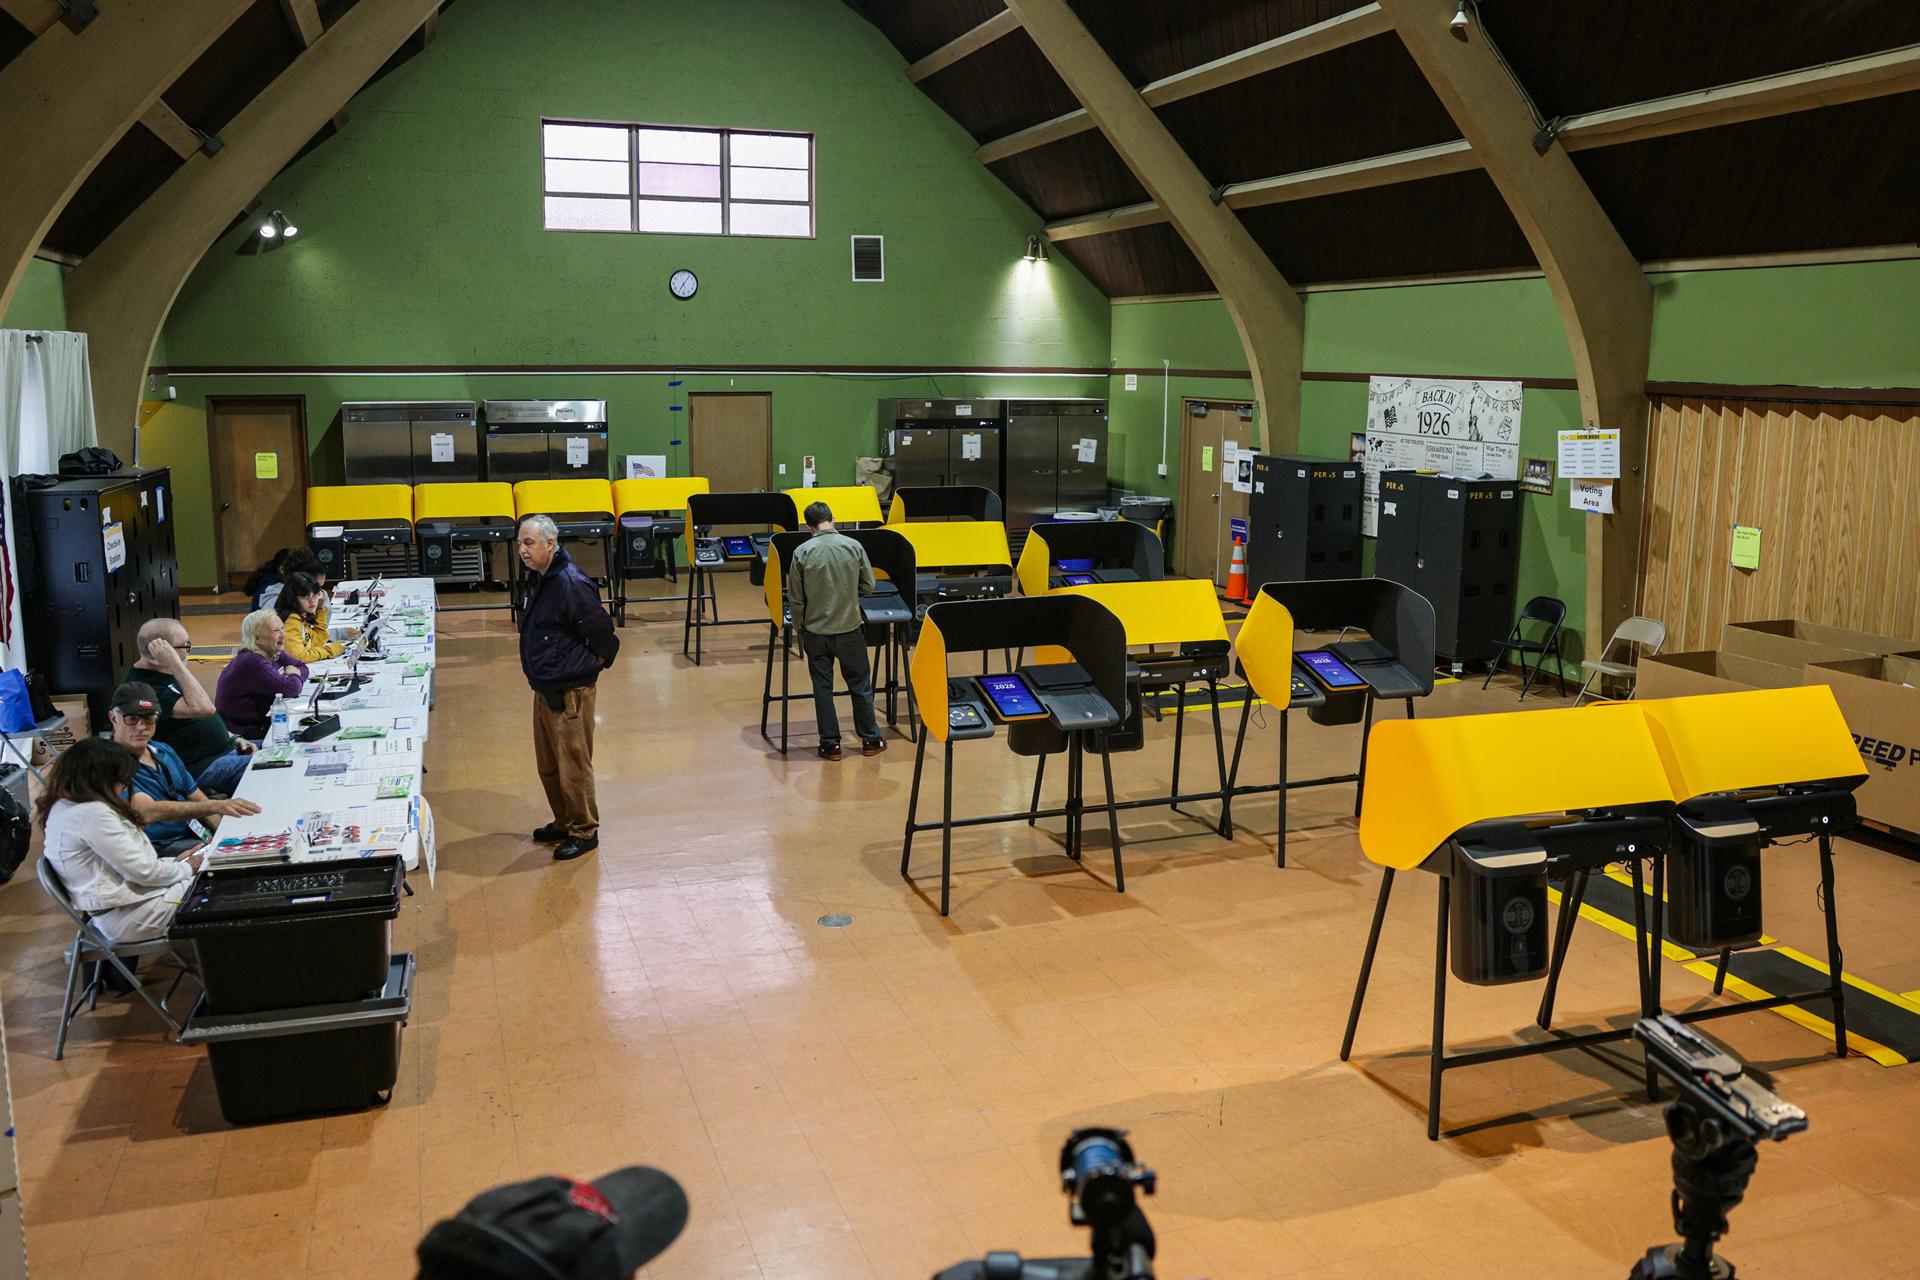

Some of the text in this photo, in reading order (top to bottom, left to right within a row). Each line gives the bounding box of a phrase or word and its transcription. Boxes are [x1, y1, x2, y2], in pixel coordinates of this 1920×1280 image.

[1422, 389, 1457, 406] BACK IN
[1417, 411, 1451, 436] 1926
[1386, 481, 1397, 490] PER
[1580, 484, 1603, 497] Voting
[1469, 491, 1484, 499] PER
[1583, 498, 1600, 507] Area
